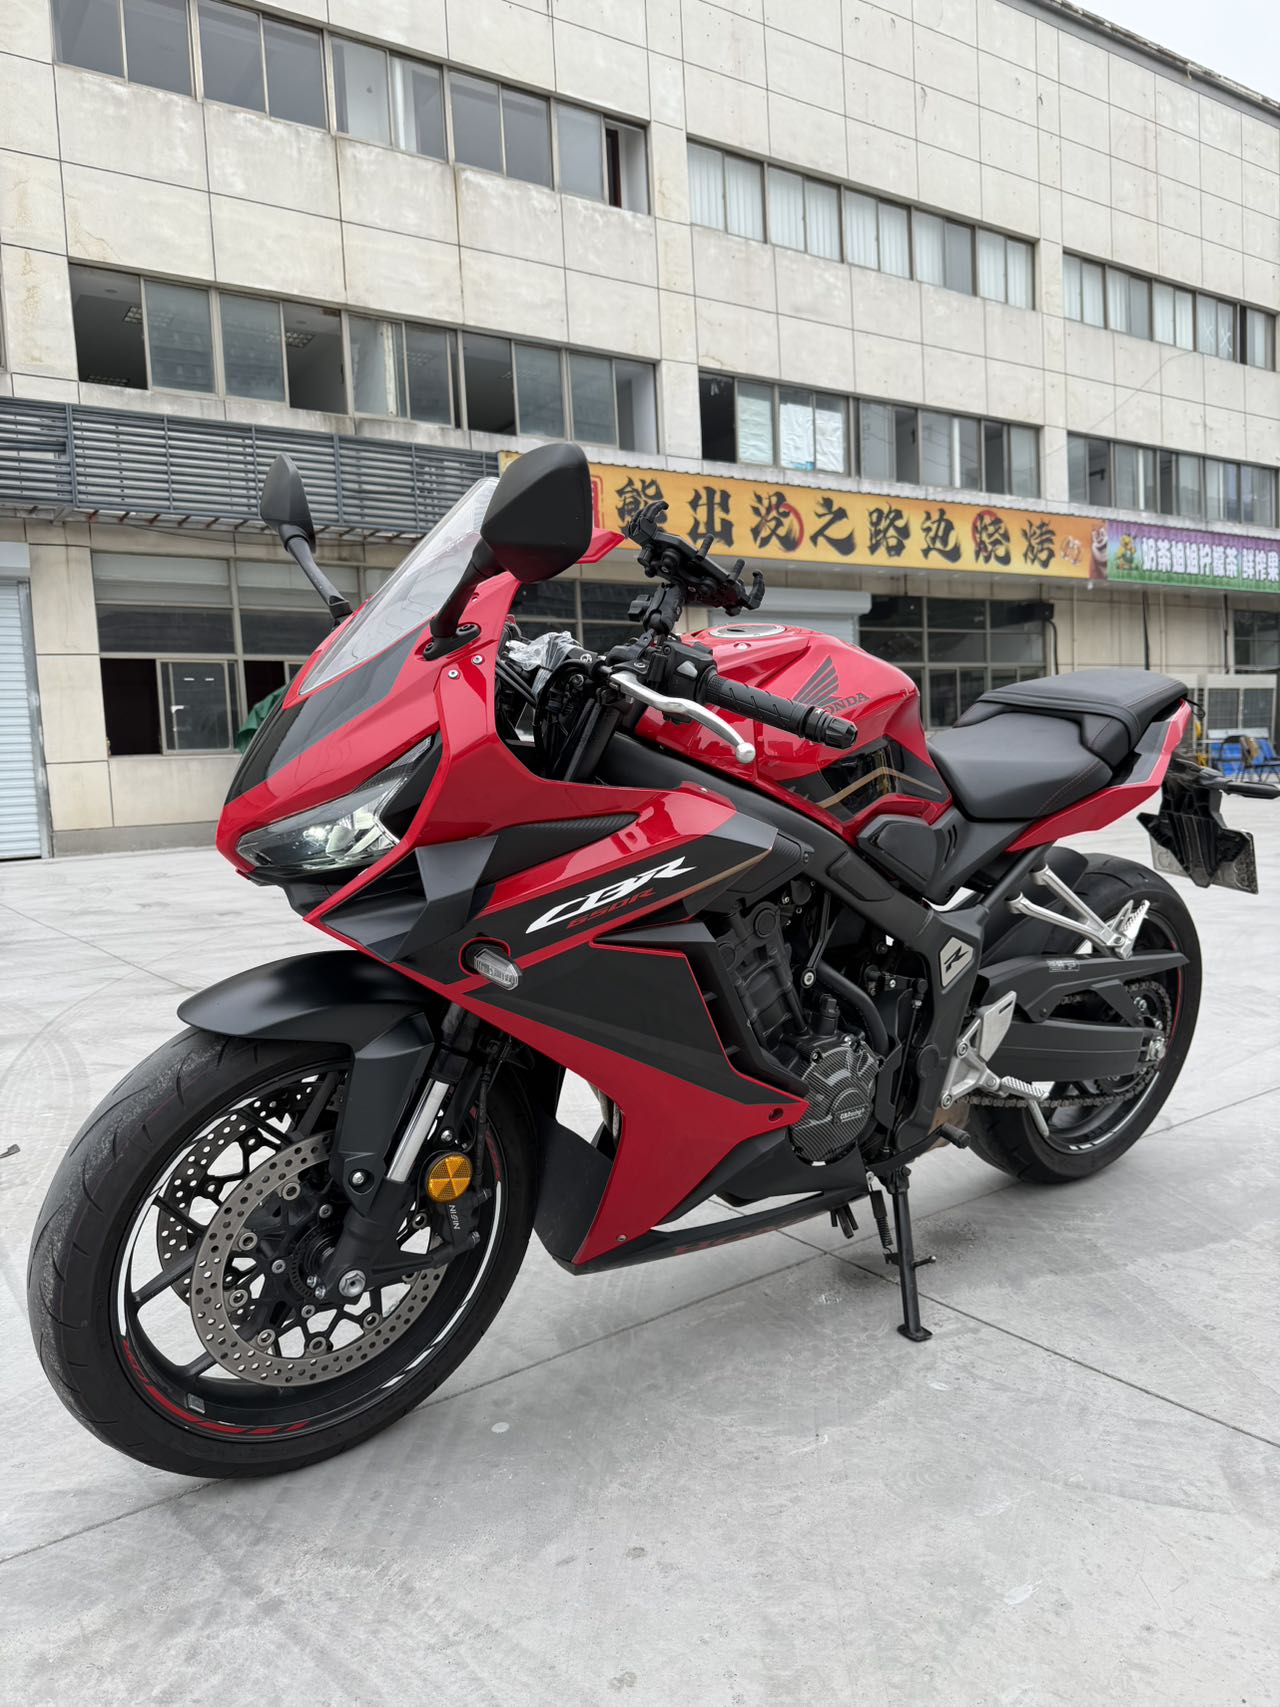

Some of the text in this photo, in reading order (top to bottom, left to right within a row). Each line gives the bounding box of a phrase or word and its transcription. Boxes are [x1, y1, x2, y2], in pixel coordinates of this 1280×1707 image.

[822, 692, 870, 715] ONDA
[525, 856, 697, 934] CBR
[566, 887, 656, 929] 650R
